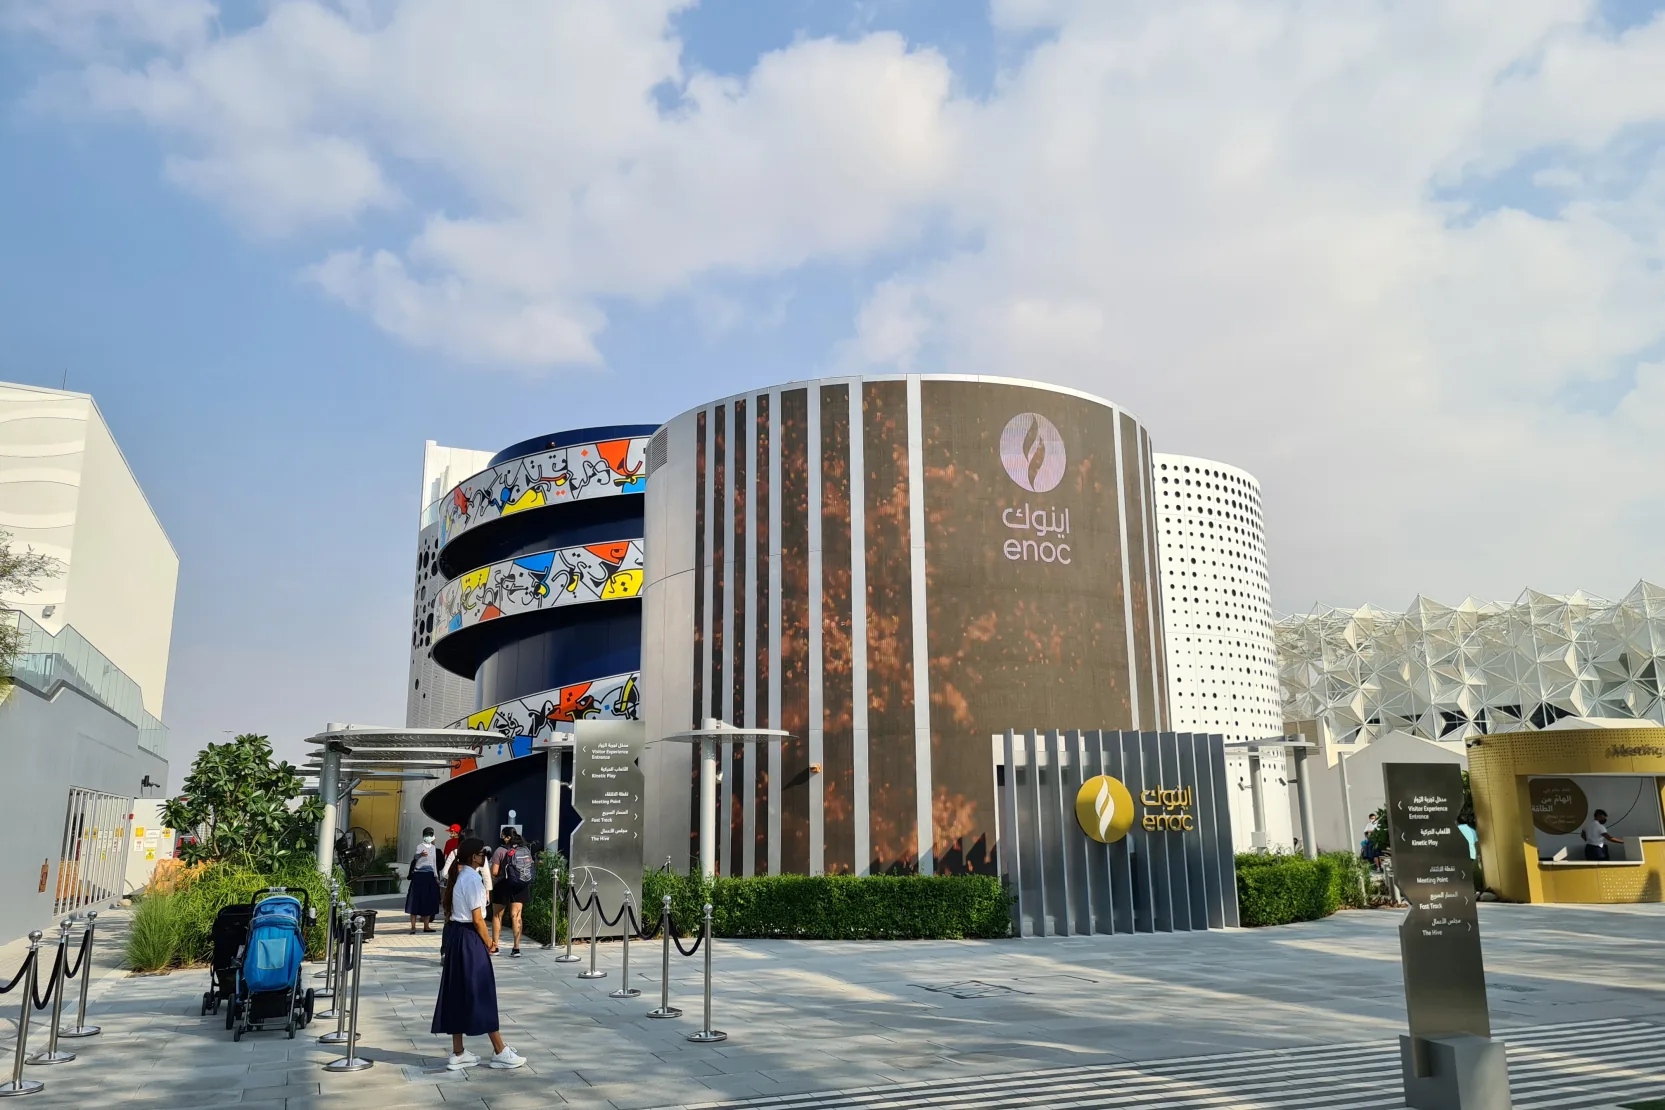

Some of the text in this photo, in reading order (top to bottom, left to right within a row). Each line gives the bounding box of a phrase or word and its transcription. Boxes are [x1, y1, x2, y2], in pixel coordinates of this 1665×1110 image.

[1003, 538, 1071, 565] enoc
[1423, 805, 1449, 813] Experience
[1142, 814, 1194, 831] enoc
[1427, 839, 1439, 847] Play
[1416, 877, 1437, 885] Meeting
[1429, 902, 1443, 910] Track
